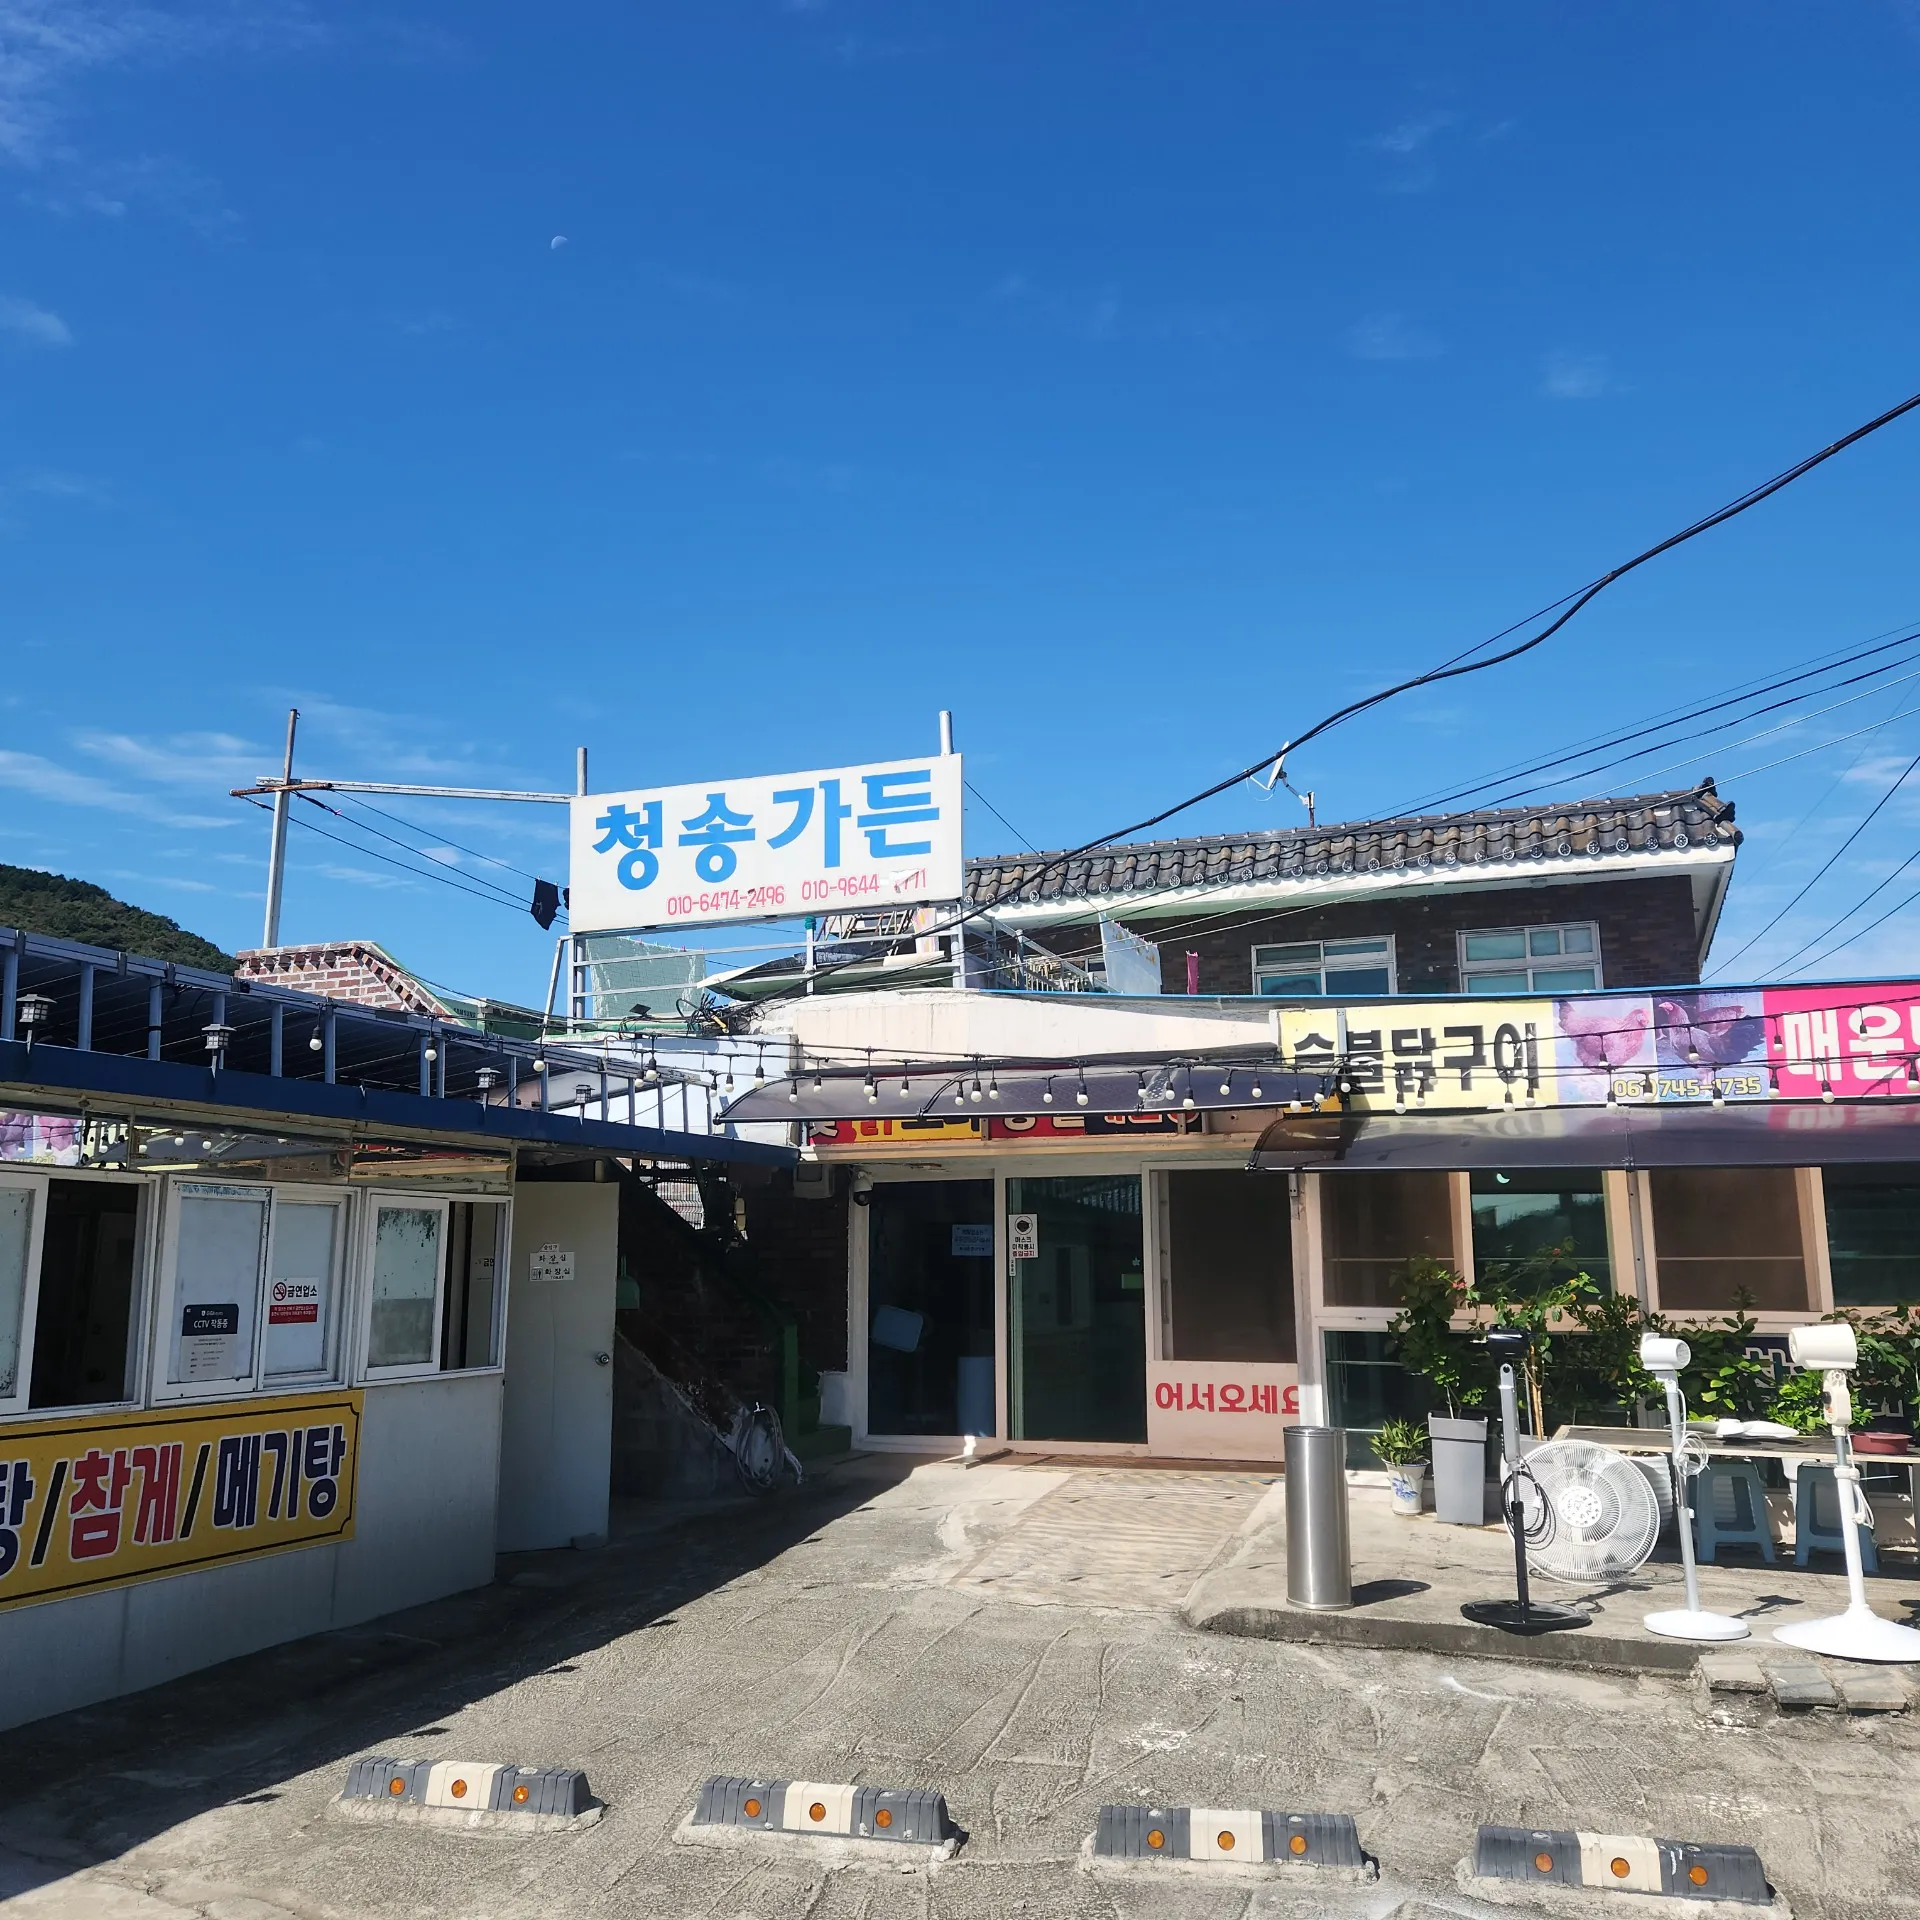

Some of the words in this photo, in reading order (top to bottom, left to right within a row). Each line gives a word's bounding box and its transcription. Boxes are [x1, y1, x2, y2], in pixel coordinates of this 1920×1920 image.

[592, 769, 939, 890] 청송가든
[667, 885, 785, 916] 010-6474-2496
[1783, 1006, 1920, 1081] 매운
[287, 1284, 318, 1298] 금연업소
[193, 1319, 210, 1329] CCTV
[211, 1318, 229, 1329] 작동중
